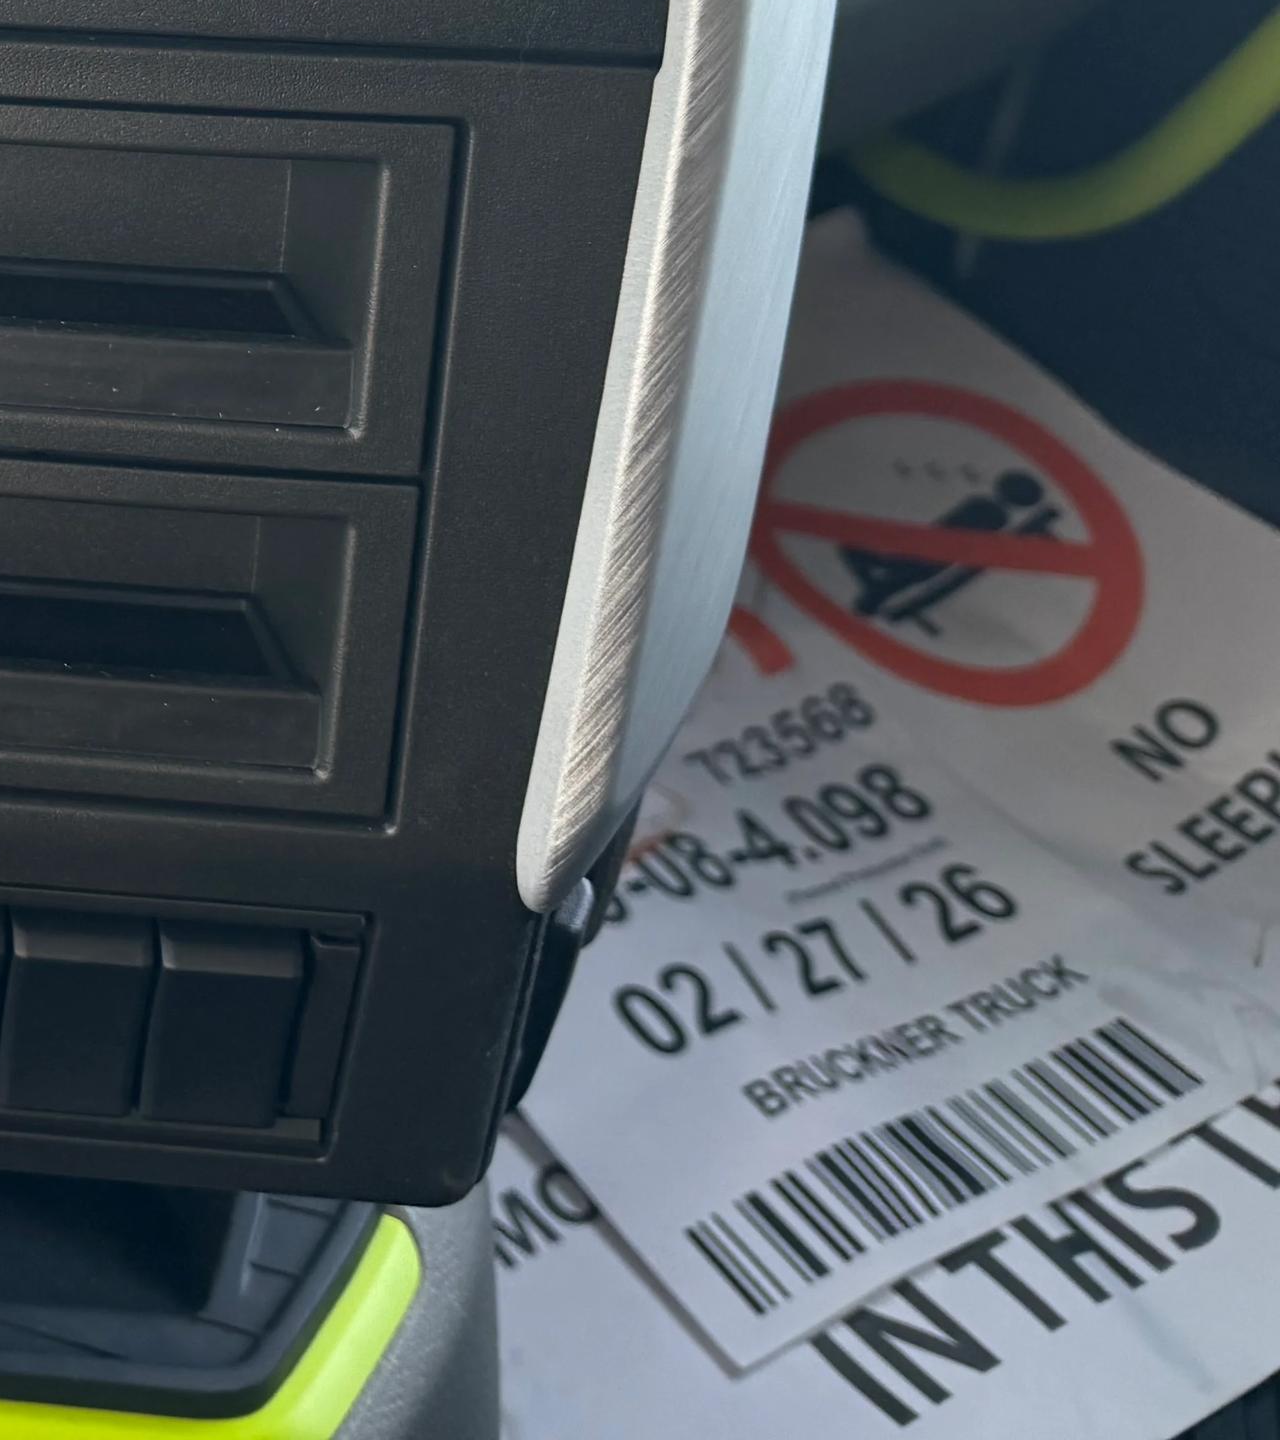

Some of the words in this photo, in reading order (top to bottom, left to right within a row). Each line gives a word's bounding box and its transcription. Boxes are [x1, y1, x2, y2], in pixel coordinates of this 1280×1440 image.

[684, 680, 874, 786] 723568
[1109, 697, 1220, 783] NO
[1124, 748, 1280, 896] SLEEP
[742, 1014, 964, 1118] BRUCKNER
[945, 955, 1090, 1033] TRUCK
[810, 1275, 1002, 1427] IN
[940, 1160, 1222, 1332] THIS
